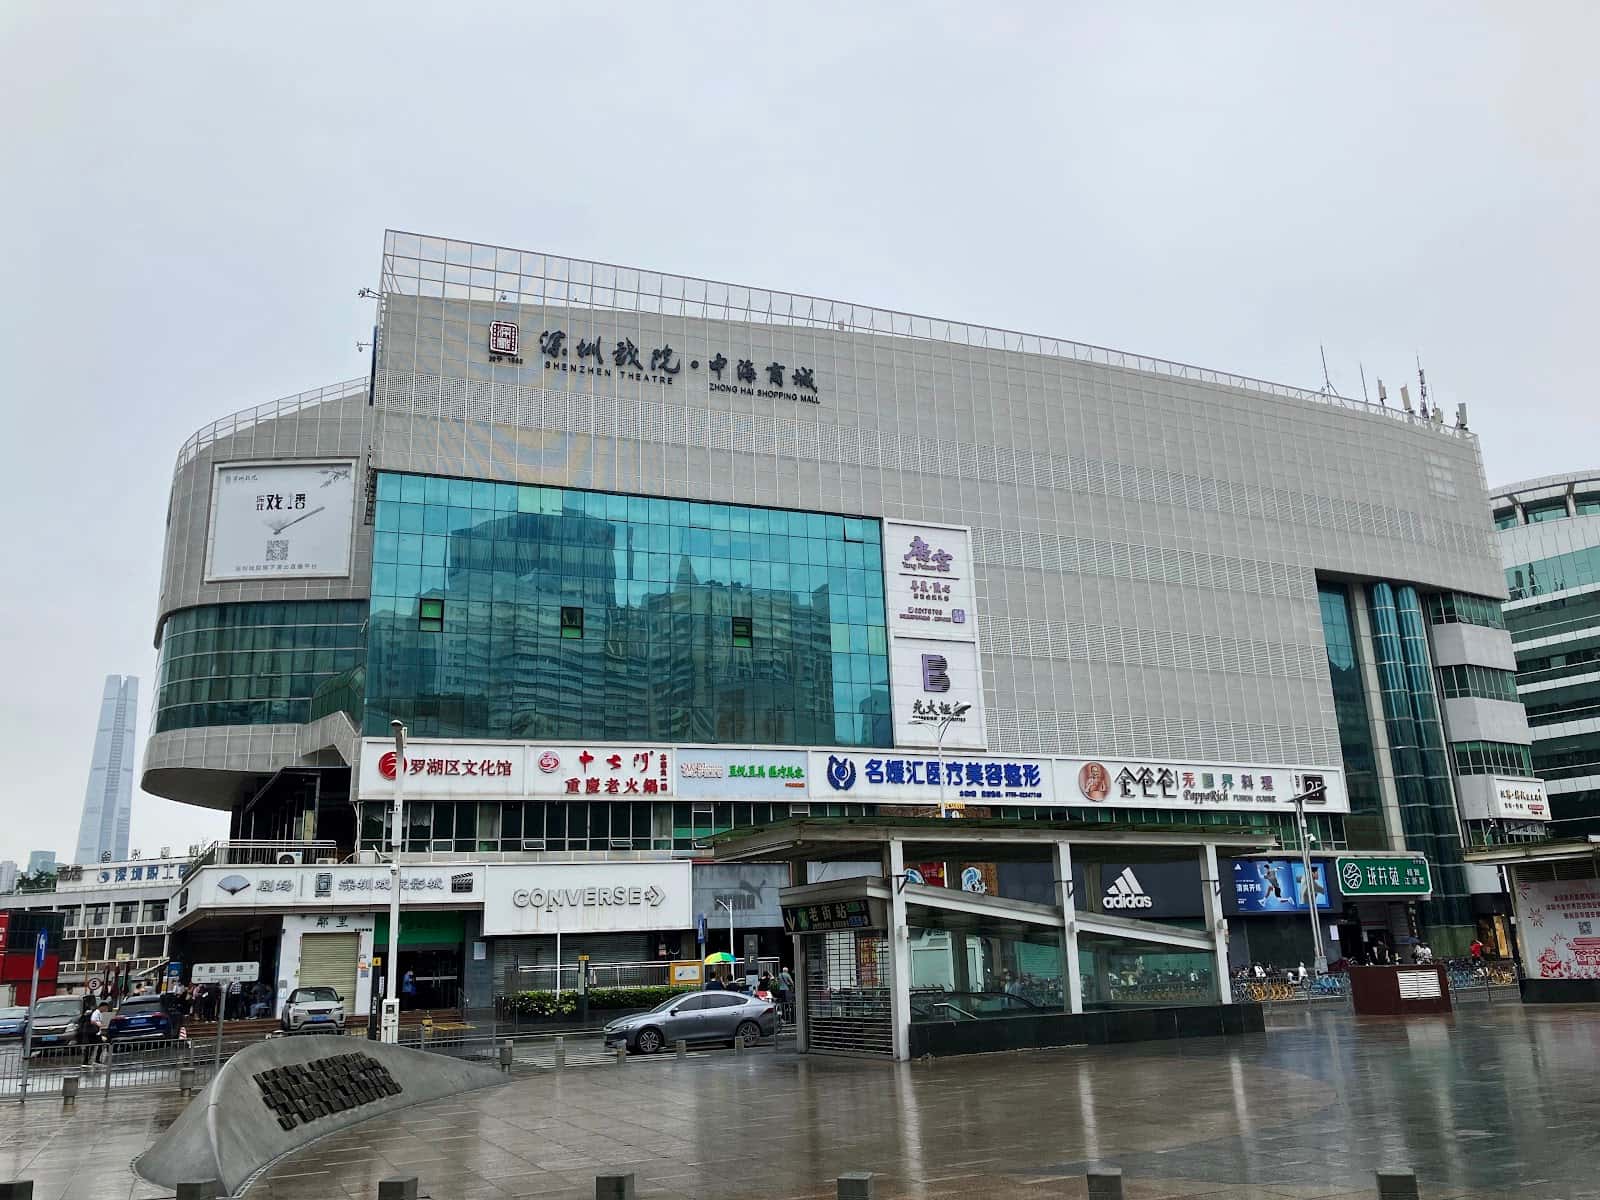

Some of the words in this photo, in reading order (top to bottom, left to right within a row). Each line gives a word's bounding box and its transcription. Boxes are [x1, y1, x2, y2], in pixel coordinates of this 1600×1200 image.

[545, 361, 611, 376] SHENZHEN
[620, 371, 673, 385] THEATRE
[709, 382, 738, 394] ZHONG
[740, 386, 754, 396] HAI
[757, 389, 798, 401] SHOPPING
[800, 394, 821, 404] MALL
[409, 758, 513, 777] 罗湖区文化馆
[865, 758, 1041, 787] 名媛汇医疗美容整形
[257, 879, 294, 892] 剧场
[513, 887, 641, 908] CONVERSE
[1103, 895, 1152, 909] adidas
[809, 902, 847, 921] 老街站
